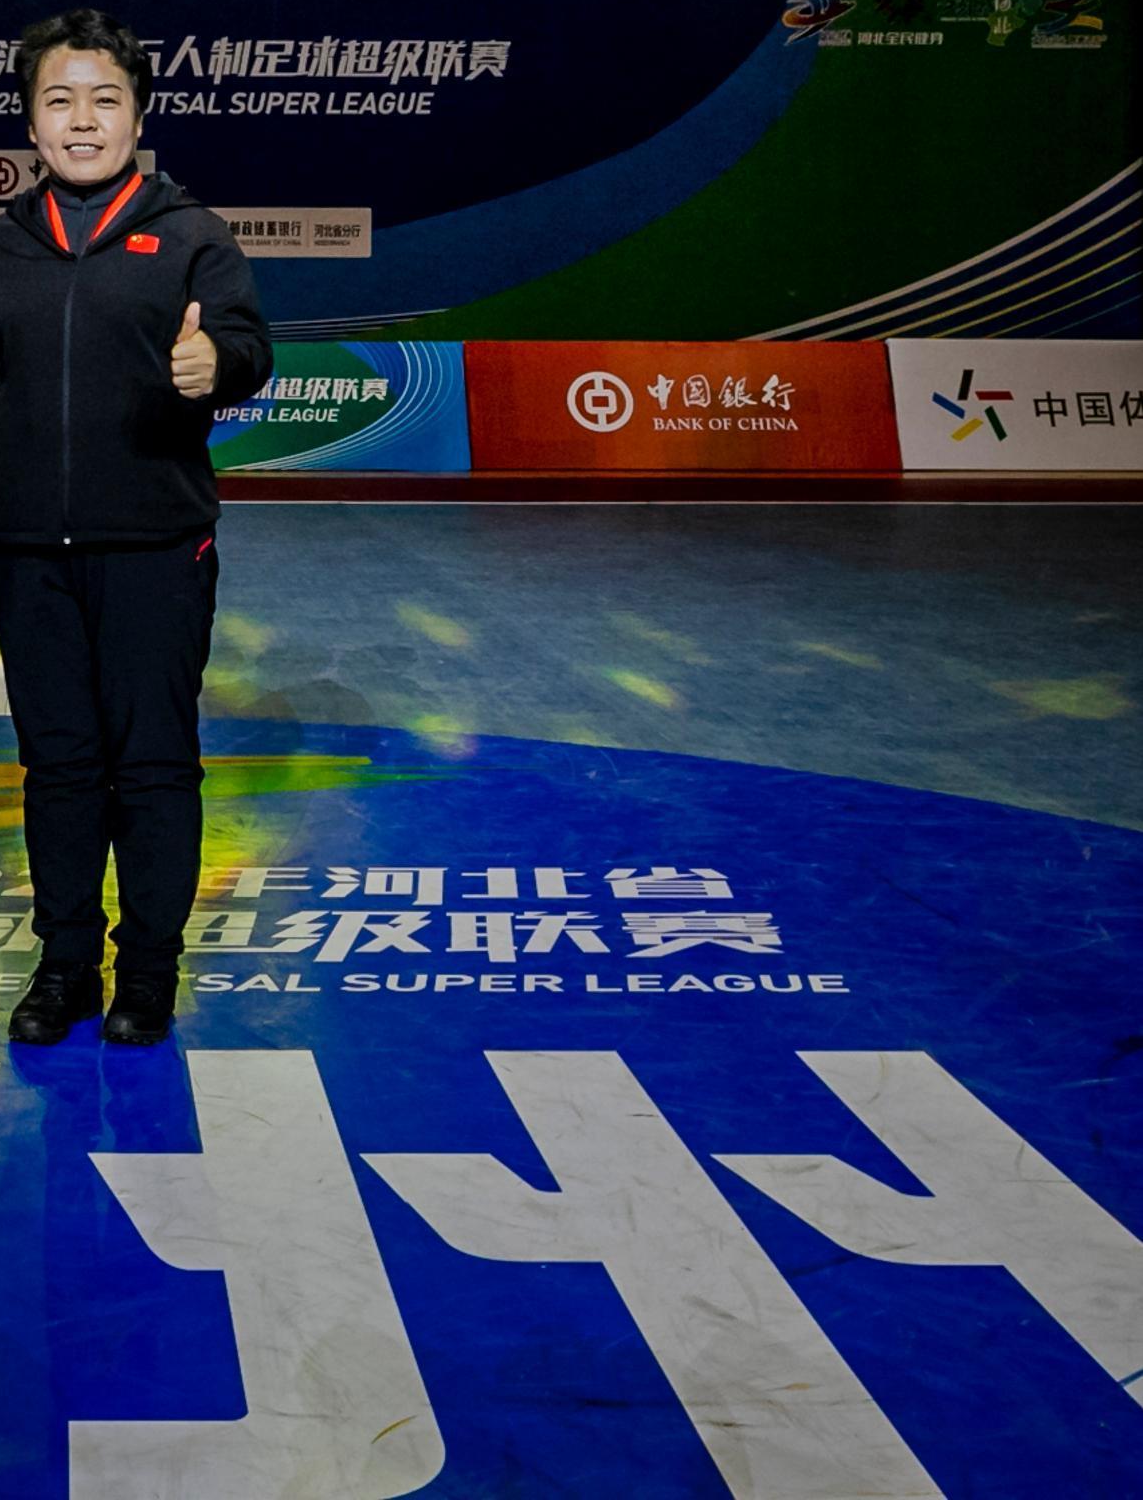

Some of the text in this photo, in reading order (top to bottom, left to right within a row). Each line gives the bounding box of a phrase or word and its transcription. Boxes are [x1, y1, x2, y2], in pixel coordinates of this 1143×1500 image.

[143, 92, 222, 116] UTSAL
[228, 92, 320, 116] SUPER
[326, 92, 435, 116] LEAGUE
[225, 221, 302, 237] 邮政储蓄银行
[213, 407, 340, 423] UPER LEAGUE
[653, 417, 799, 431] BANK OF CHINA
[179, 973, 321, 993] SAL
[341, 973, 564, 993] SUPER
[586, 973, 850, 994] LEAGUE
